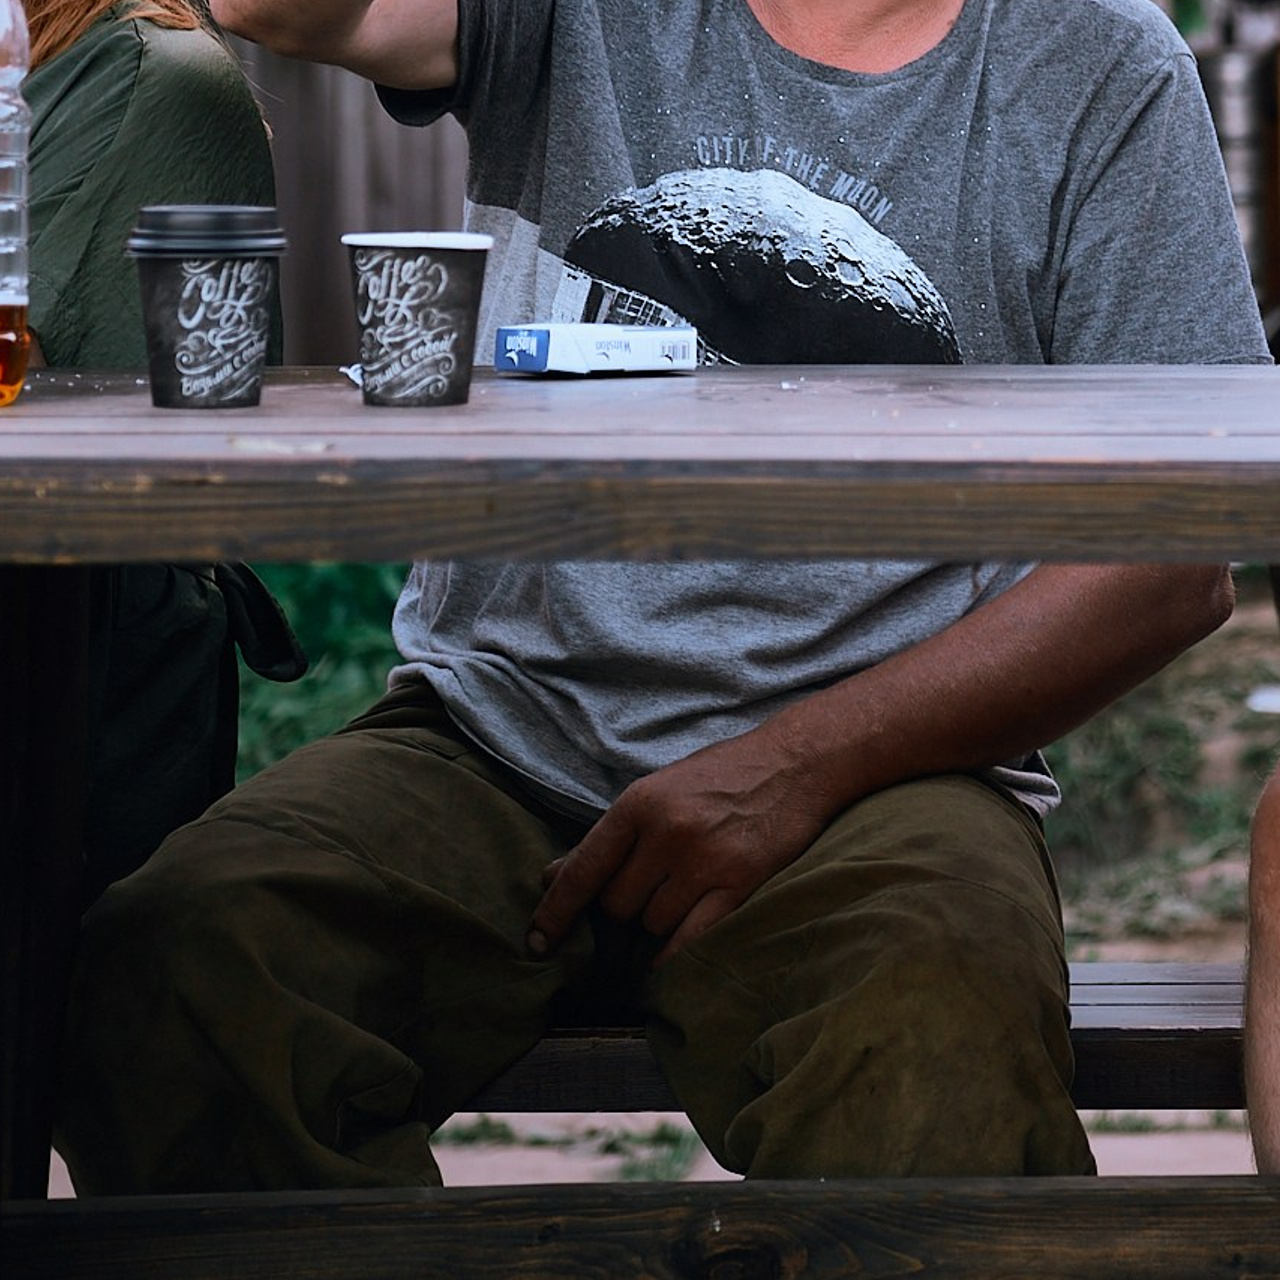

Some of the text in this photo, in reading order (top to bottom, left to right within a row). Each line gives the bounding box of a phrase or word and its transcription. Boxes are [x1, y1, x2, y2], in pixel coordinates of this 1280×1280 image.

[697, 135, 748, 165] CITY
[785, 147, 829, 190] THE
[829, 170, 893, 224] MOON
[595, 341, 632, 354] Winston
